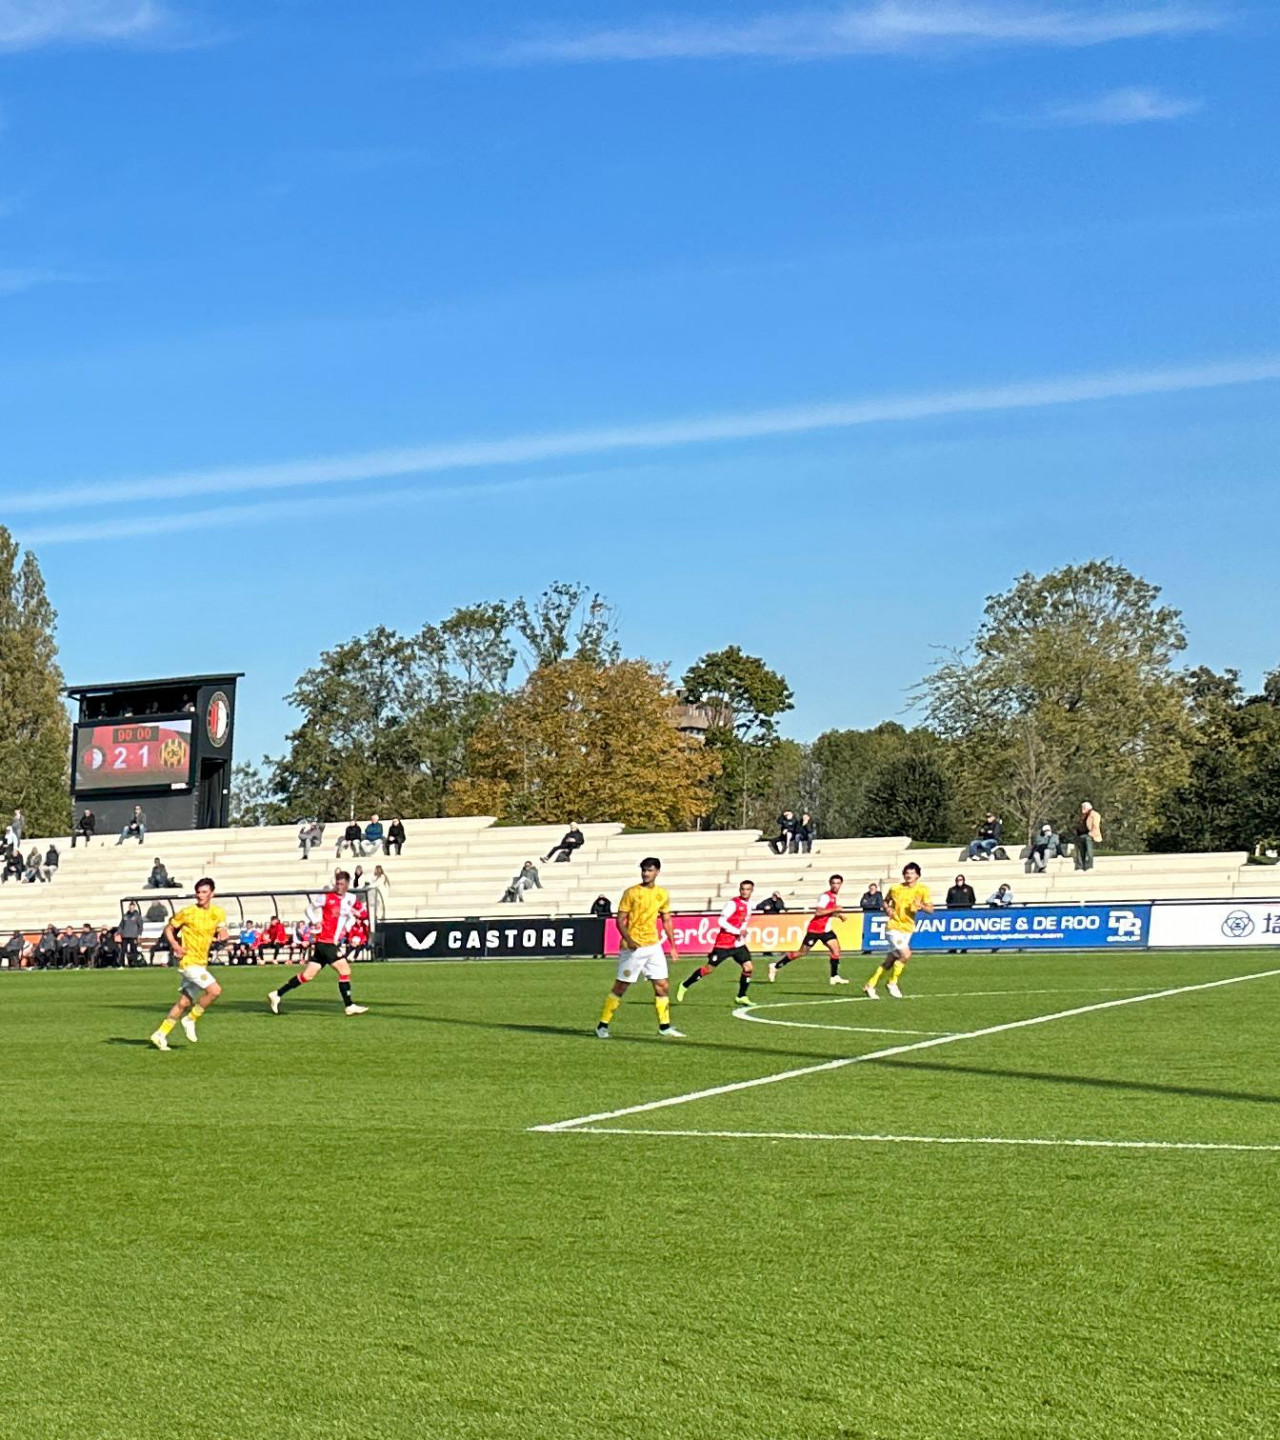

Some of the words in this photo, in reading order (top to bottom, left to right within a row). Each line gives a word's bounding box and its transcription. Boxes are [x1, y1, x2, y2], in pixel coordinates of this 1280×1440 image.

[113, 747, 127, 769] 2
[139, 745, 149, 767] 1
[950, 917, 1011, 932] DONGE
[1015, 917, 1029, 930] &
[1033, 916, 1057, 929] DE
[1061, 915, 1100, 930] ROO
[448, 928, 575, 949] CASTORE
